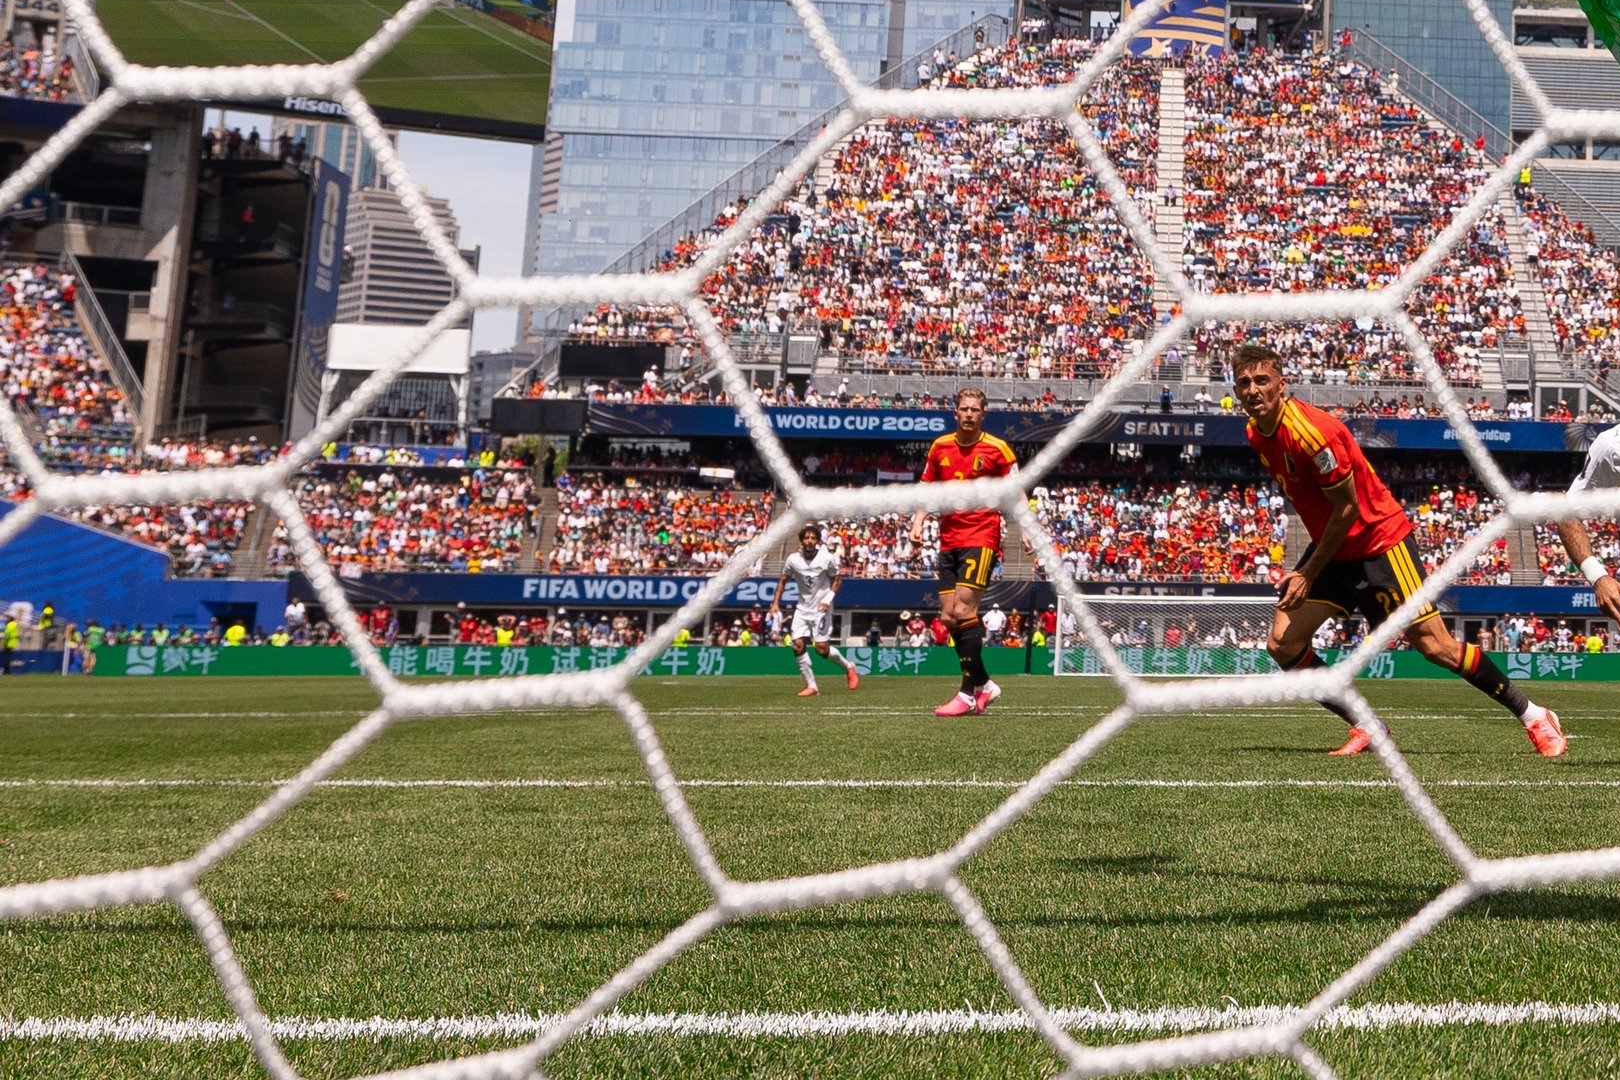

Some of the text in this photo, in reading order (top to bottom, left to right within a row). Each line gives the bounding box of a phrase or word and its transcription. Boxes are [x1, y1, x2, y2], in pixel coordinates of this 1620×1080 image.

[283, 95, 350, 117] Hisens
[734, 414, 946, 432] FIA WORLD CUP 2026
[1124, 421, 1205, 436] SEATTLE
[1443, 429, 1511, 443] #FIorldCup
[965, 558, 977, 580] 7
[523, 579, 800, 602] FIFA WORLD CP 202
[161, 646, 726, 676] 蒙牛 能喝牛奶 试试牛奶
[877, 648, 928, 675] 蒙牛
[1536, 653, 1584, 680] 蒙牛
